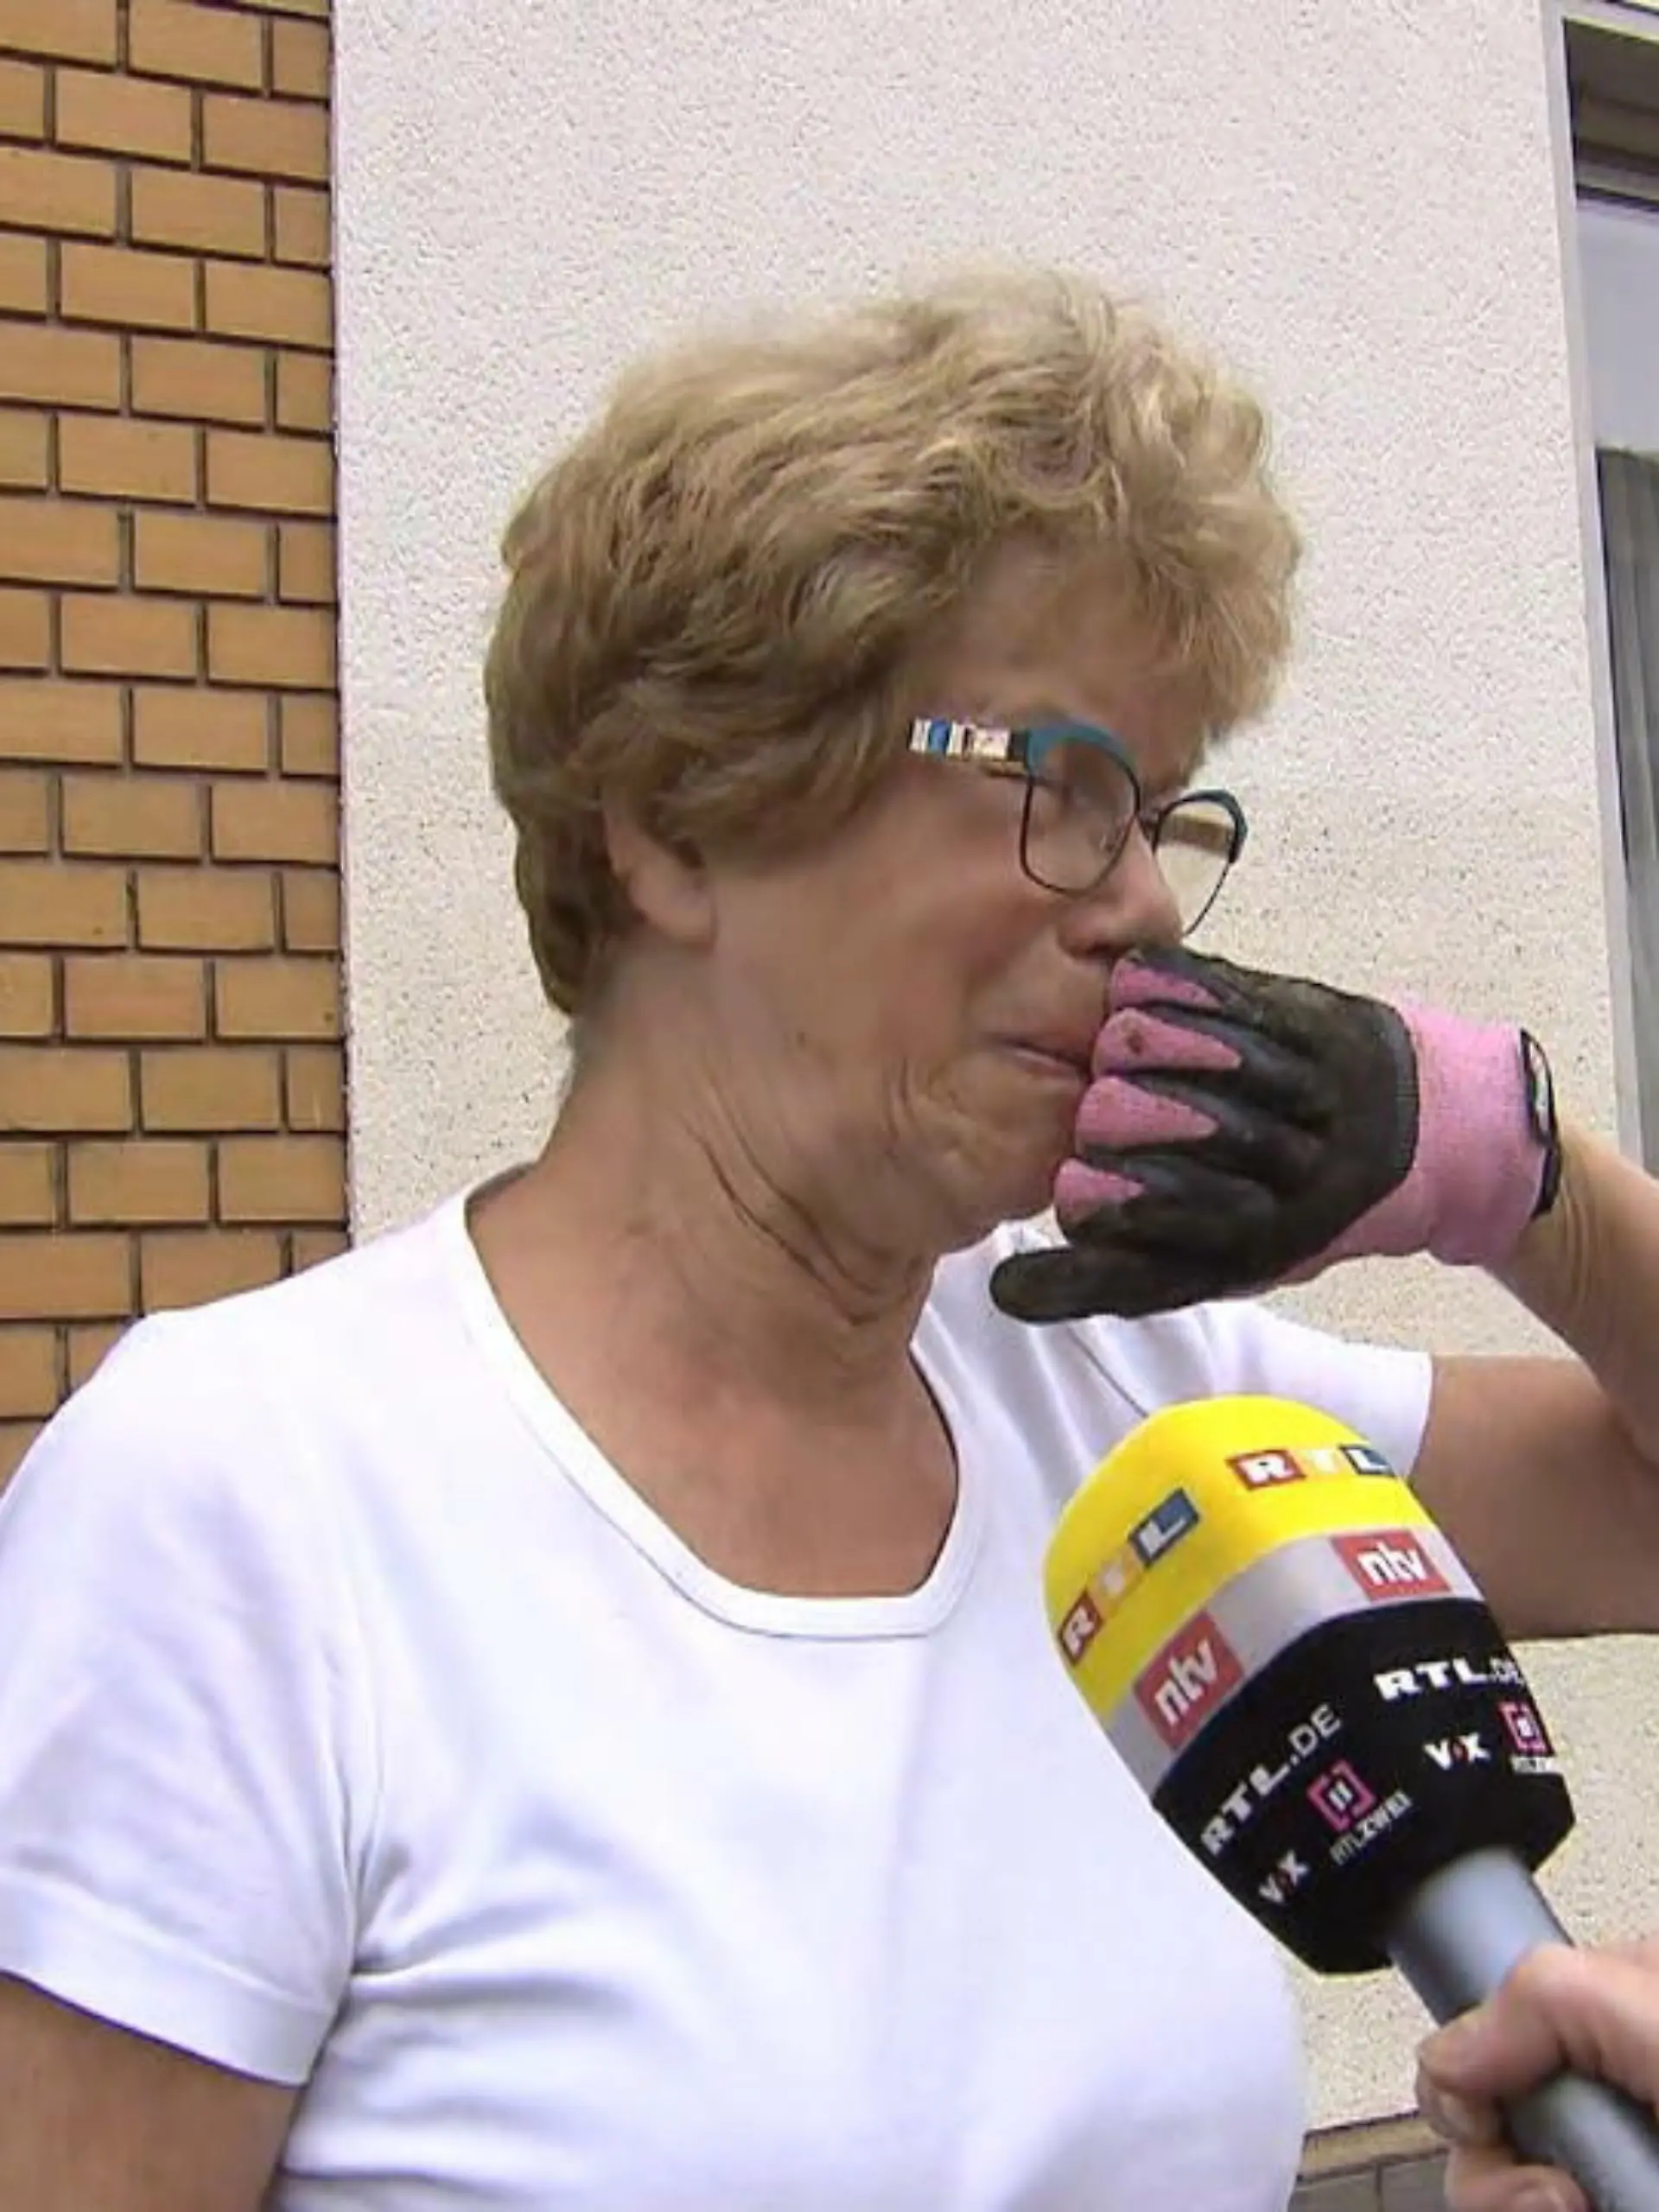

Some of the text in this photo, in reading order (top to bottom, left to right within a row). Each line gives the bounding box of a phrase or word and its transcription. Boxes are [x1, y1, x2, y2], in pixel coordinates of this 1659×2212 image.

[1236, 1447, 1390, 1484] RTL
[1357, 1541, 1427, 1586] ntv
[1154, 1637, 1217, 1726] ntv
[1200, 1703, 1341, 1855] RTL.DE
